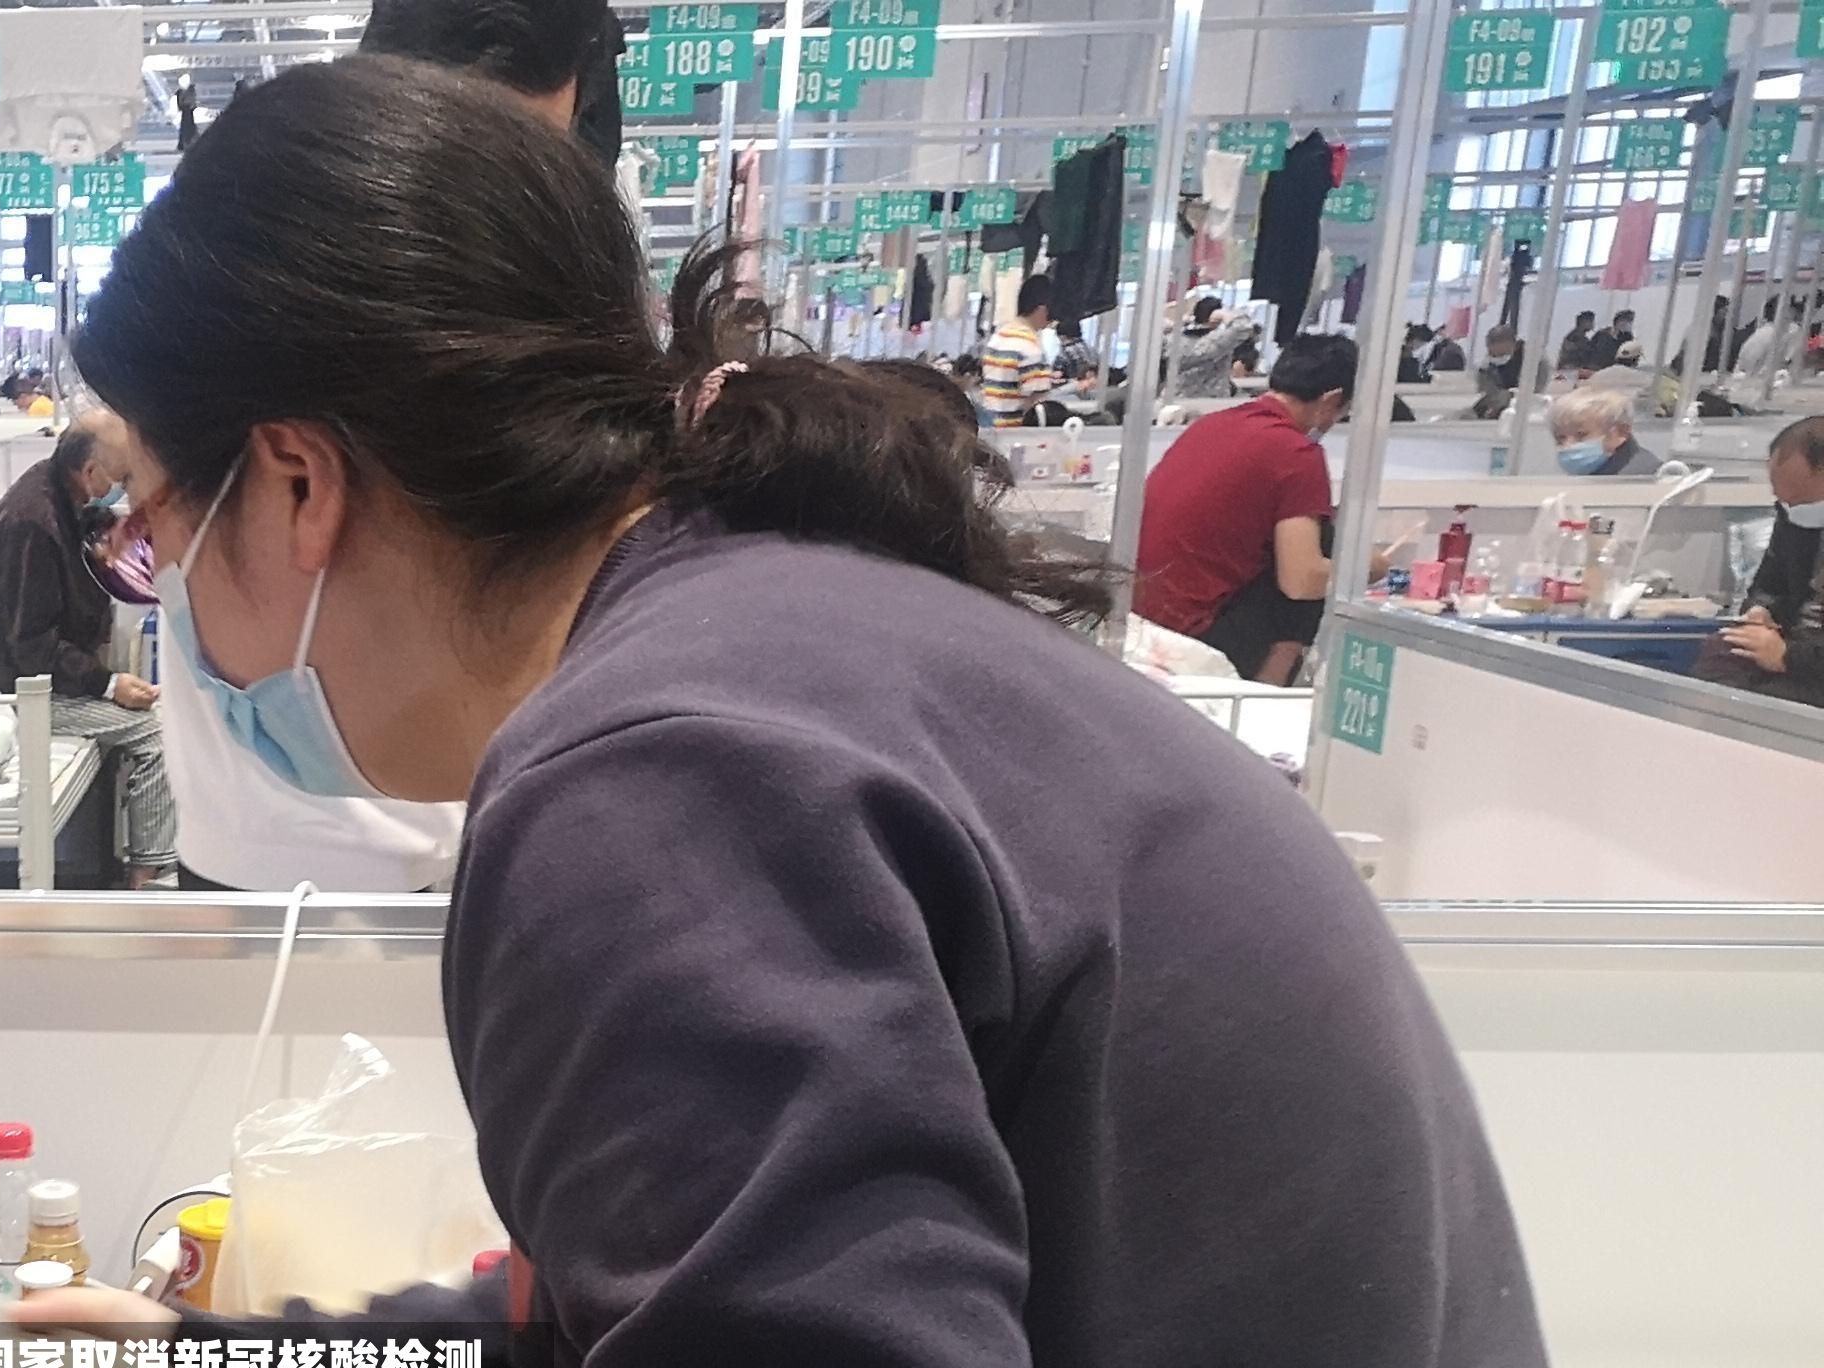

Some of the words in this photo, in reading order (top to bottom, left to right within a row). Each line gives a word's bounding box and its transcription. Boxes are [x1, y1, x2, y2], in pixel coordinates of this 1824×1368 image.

[666, 4, 721, 29] F4-09
[1617, 16, 1667, 53] 192
[665, 39, 712, 76] 188
[845, 34, 894, 71] 190
[1464, 51, 1506, 84] 191
[83, 172, 110, 195] 175
